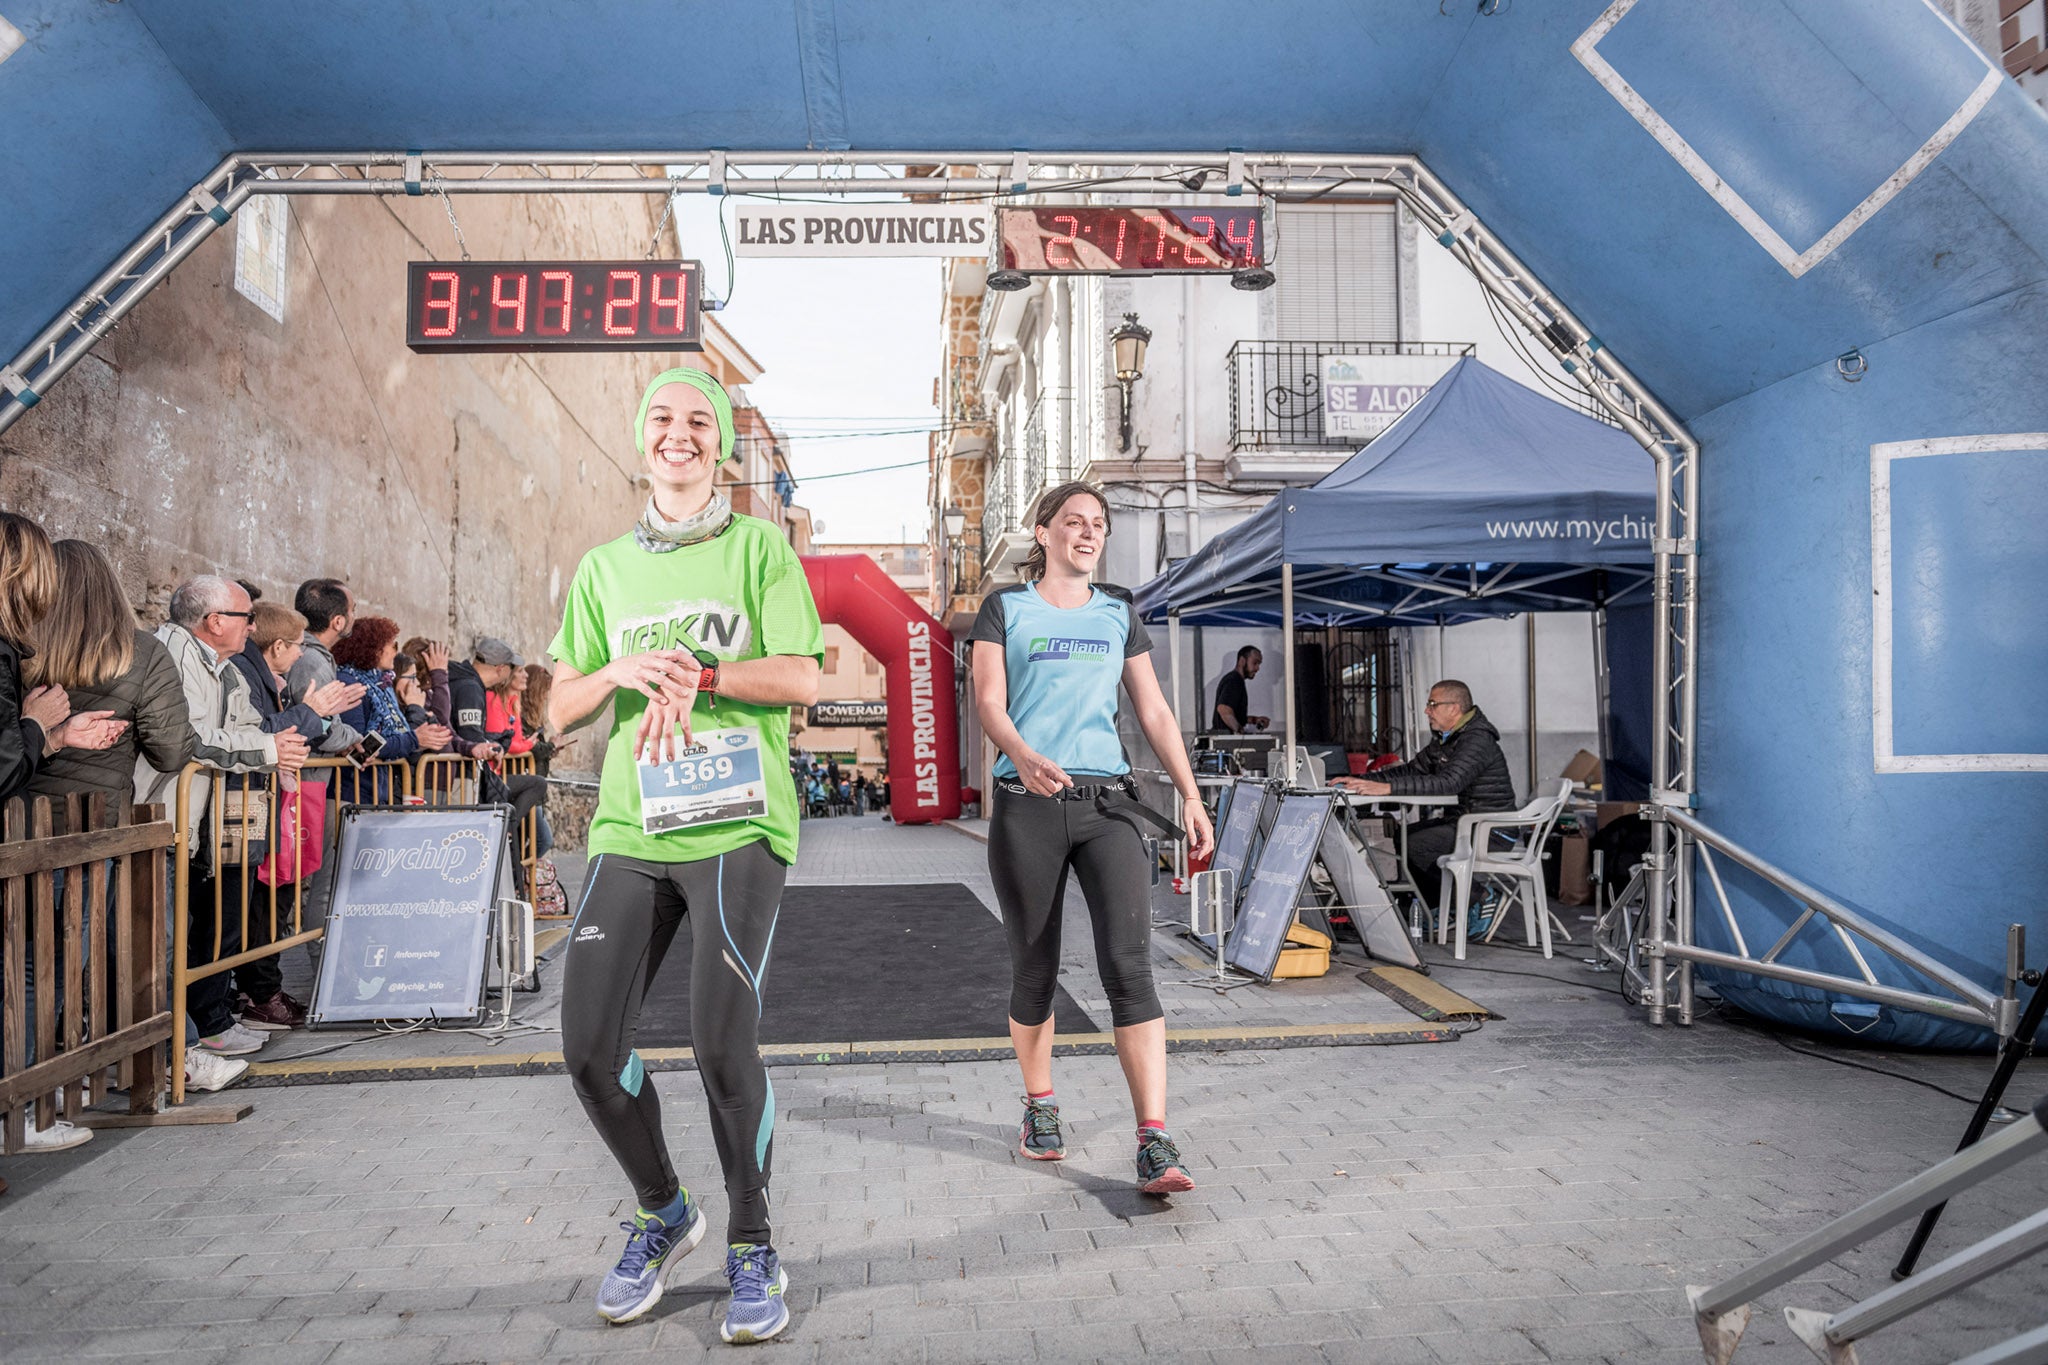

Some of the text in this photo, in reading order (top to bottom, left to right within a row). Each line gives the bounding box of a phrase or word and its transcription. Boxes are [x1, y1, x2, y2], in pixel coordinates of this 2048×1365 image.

[739, 217, 986, 244] LAS PROVINCIAS
[1330, 387, 1358, 411] SE
[907, 621, 940, 807] LAS PROVINCIAS
[664, 756, 733, 788] 1369
[353, 839, 466, 877] mychip
[344, 899, 479, 918] www.mychip.es
